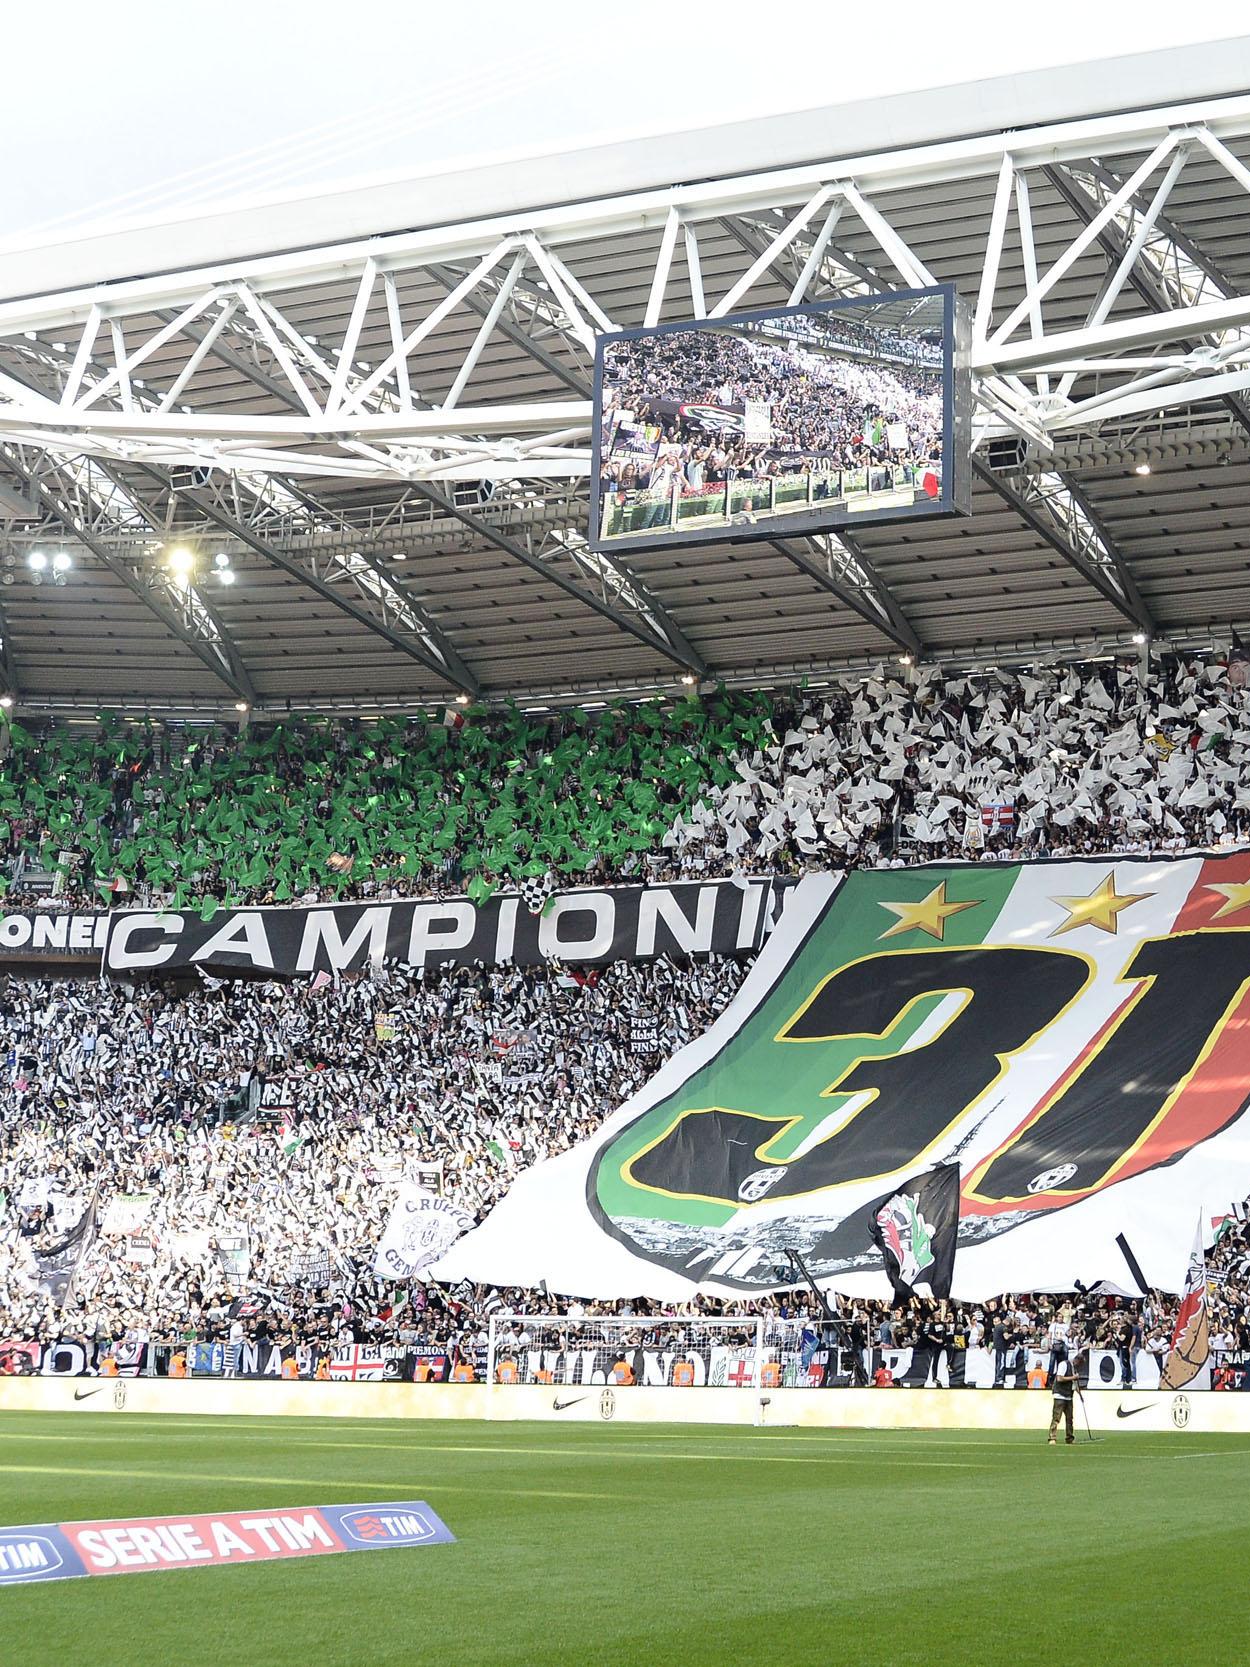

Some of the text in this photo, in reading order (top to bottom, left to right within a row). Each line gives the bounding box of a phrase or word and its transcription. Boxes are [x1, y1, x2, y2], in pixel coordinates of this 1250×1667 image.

[108, 884, 764, 970] CAMPIONI
[77, 1514, 334, 1568] SERIE A TIM
[381, 1515, 425, 1537] TIM
